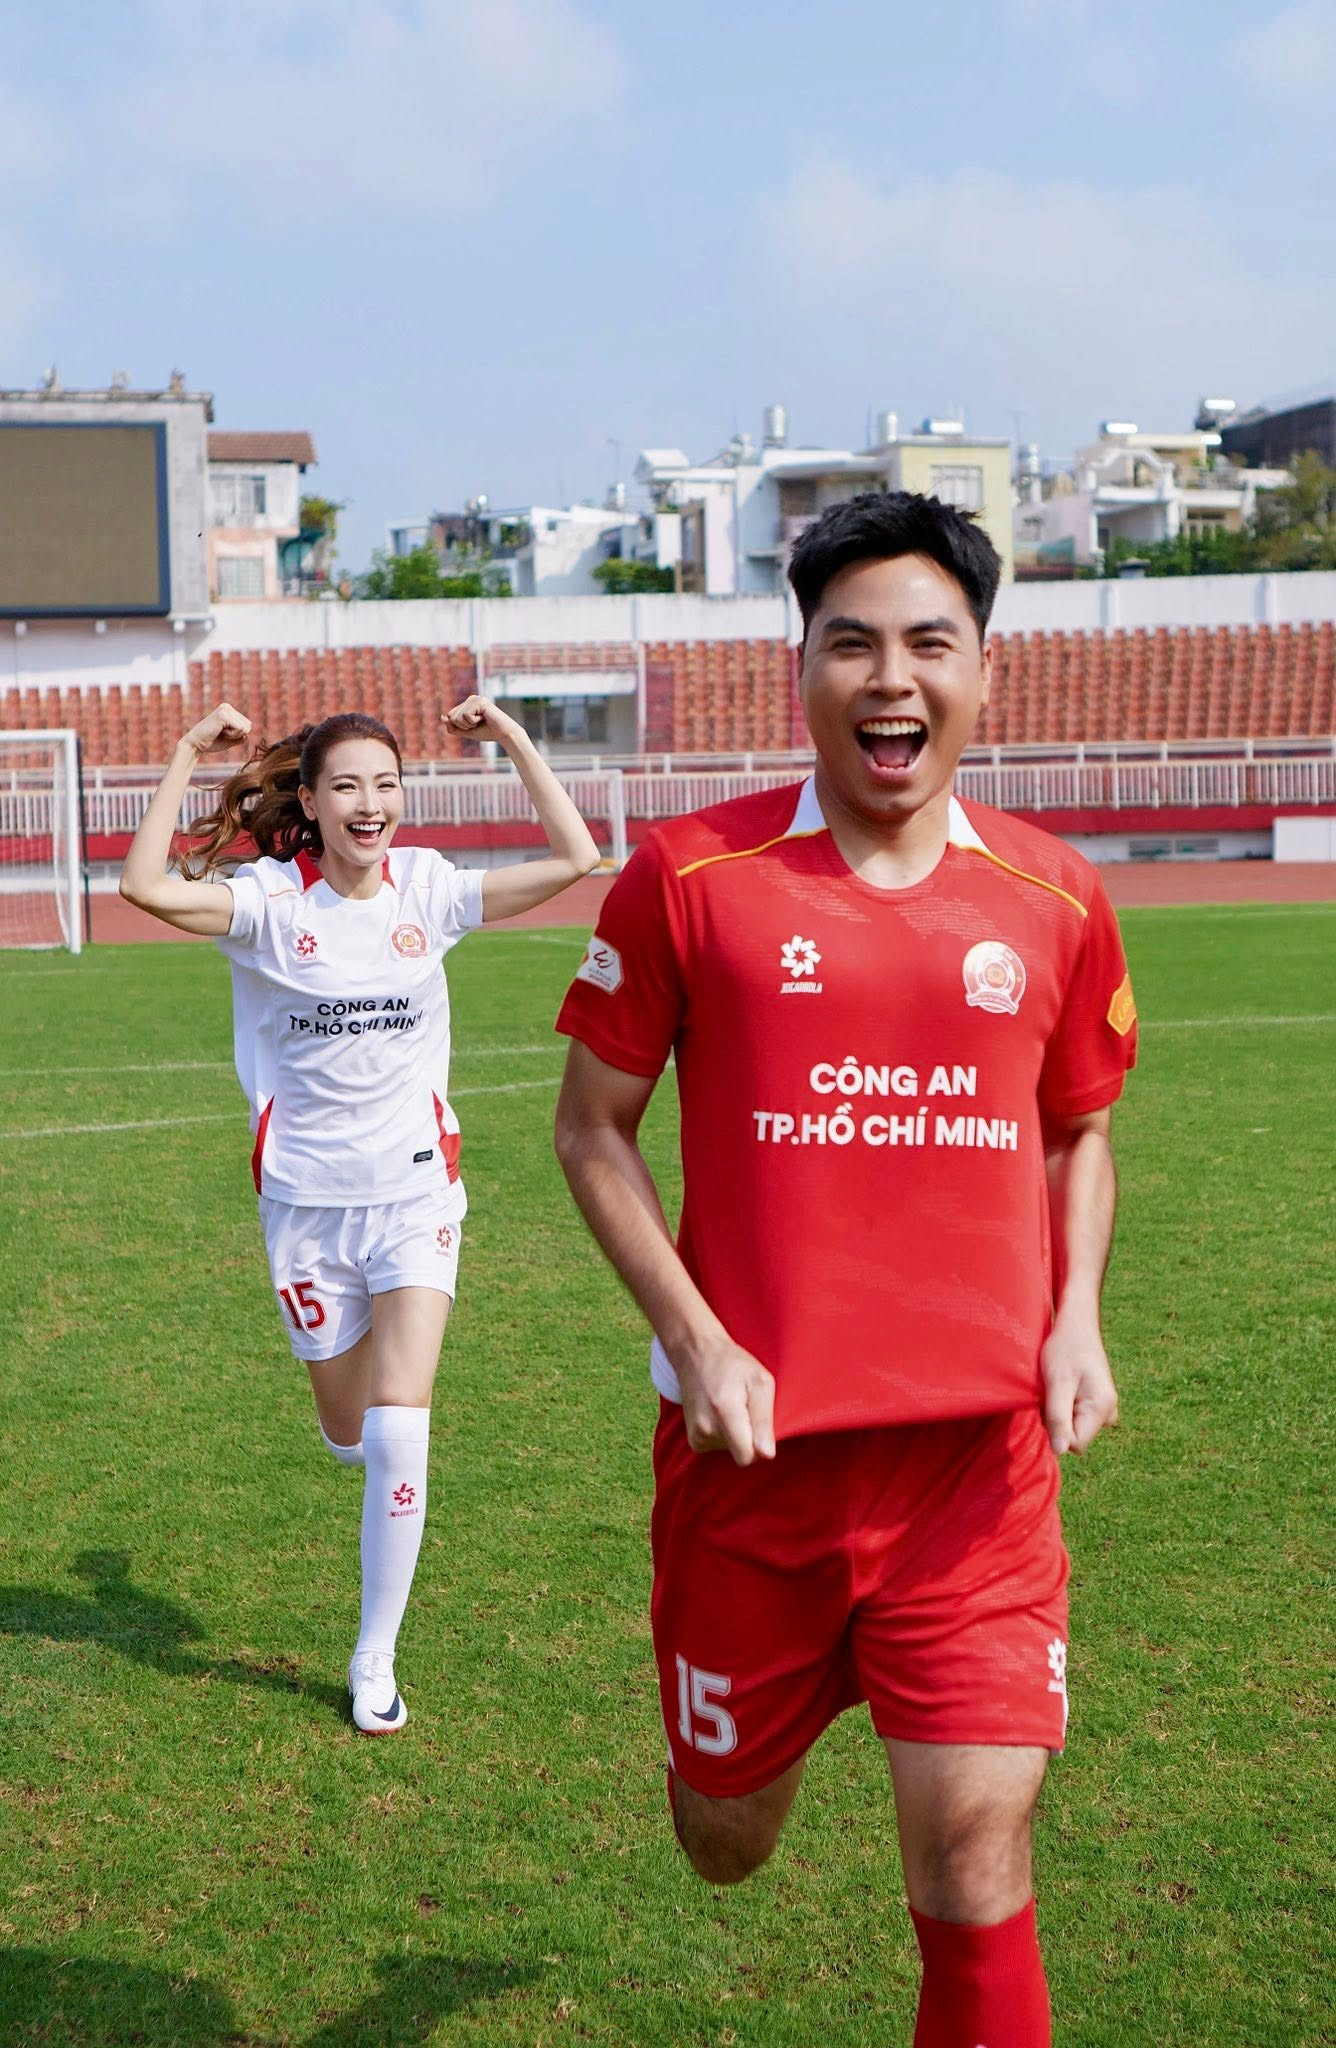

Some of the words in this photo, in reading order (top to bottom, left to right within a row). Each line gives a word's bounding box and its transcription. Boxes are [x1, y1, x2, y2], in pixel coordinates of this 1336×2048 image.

[289, 1014, 343, 1035] TP.HỒ
[317, 1000, 376, 1016] CÔNG
[382, 997, 409, 1011] AN
[809, 1056, 918, 1096] CÔNG
[926, 1065, 977, 1096] AN
[753, 1102, 856, 1145] TP.HỒ
[861, 1106, 929, 1146] CHÍ
[935, 1115, 1018, 1151] MINH
[277, 1279, 327, 1331] 15
[676, 1652, 738, 1756] 15
